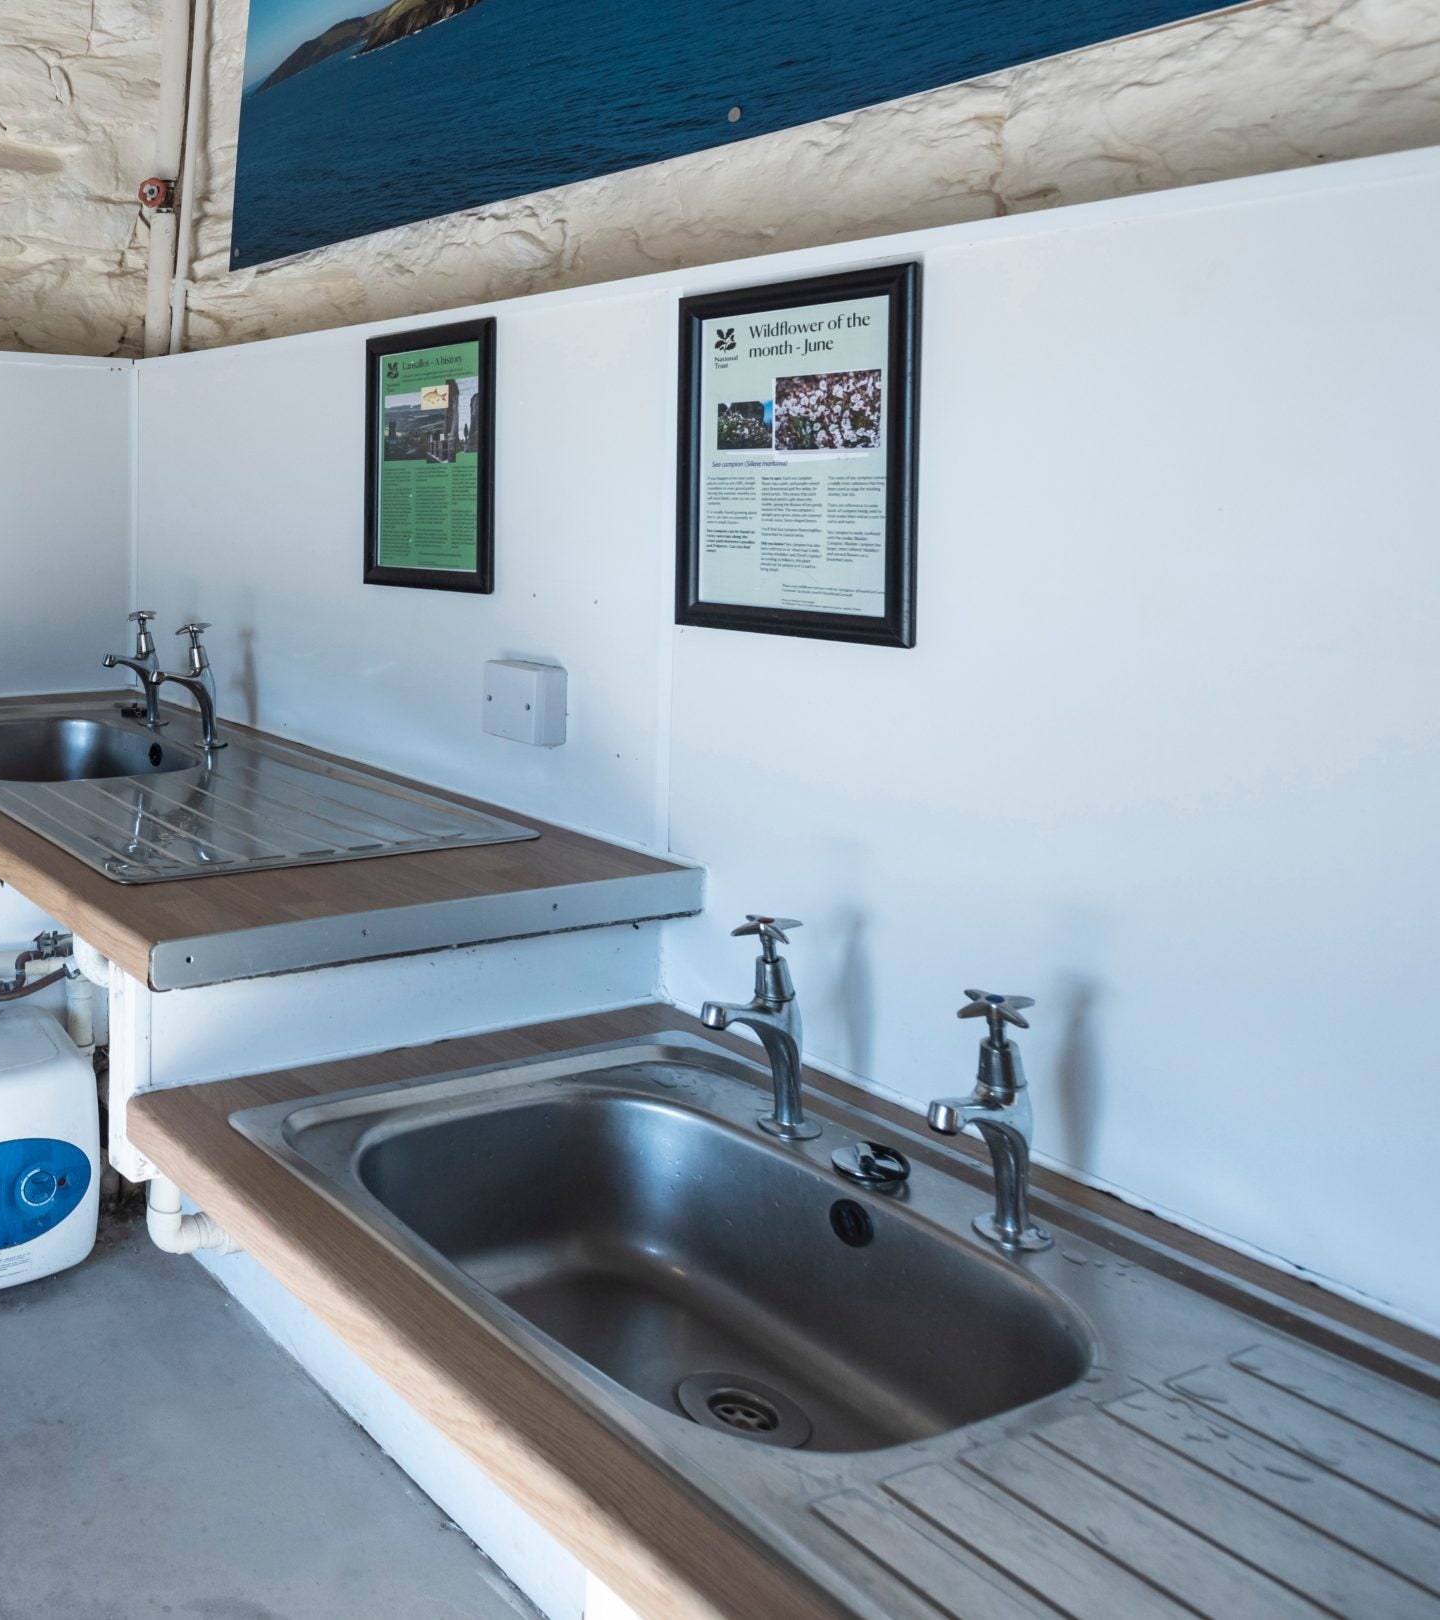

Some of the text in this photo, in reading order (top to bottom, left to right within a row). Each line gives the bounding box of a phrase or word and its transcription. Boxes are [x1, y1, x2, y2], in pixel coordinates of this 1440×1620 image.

[749, 312, 871, 339] Wildflower of the
[749, 340, 793, 358] month
[801, 338, 834, 356] June
[440, 355, 462, 366] history
[714, 354, 738, 363] National
